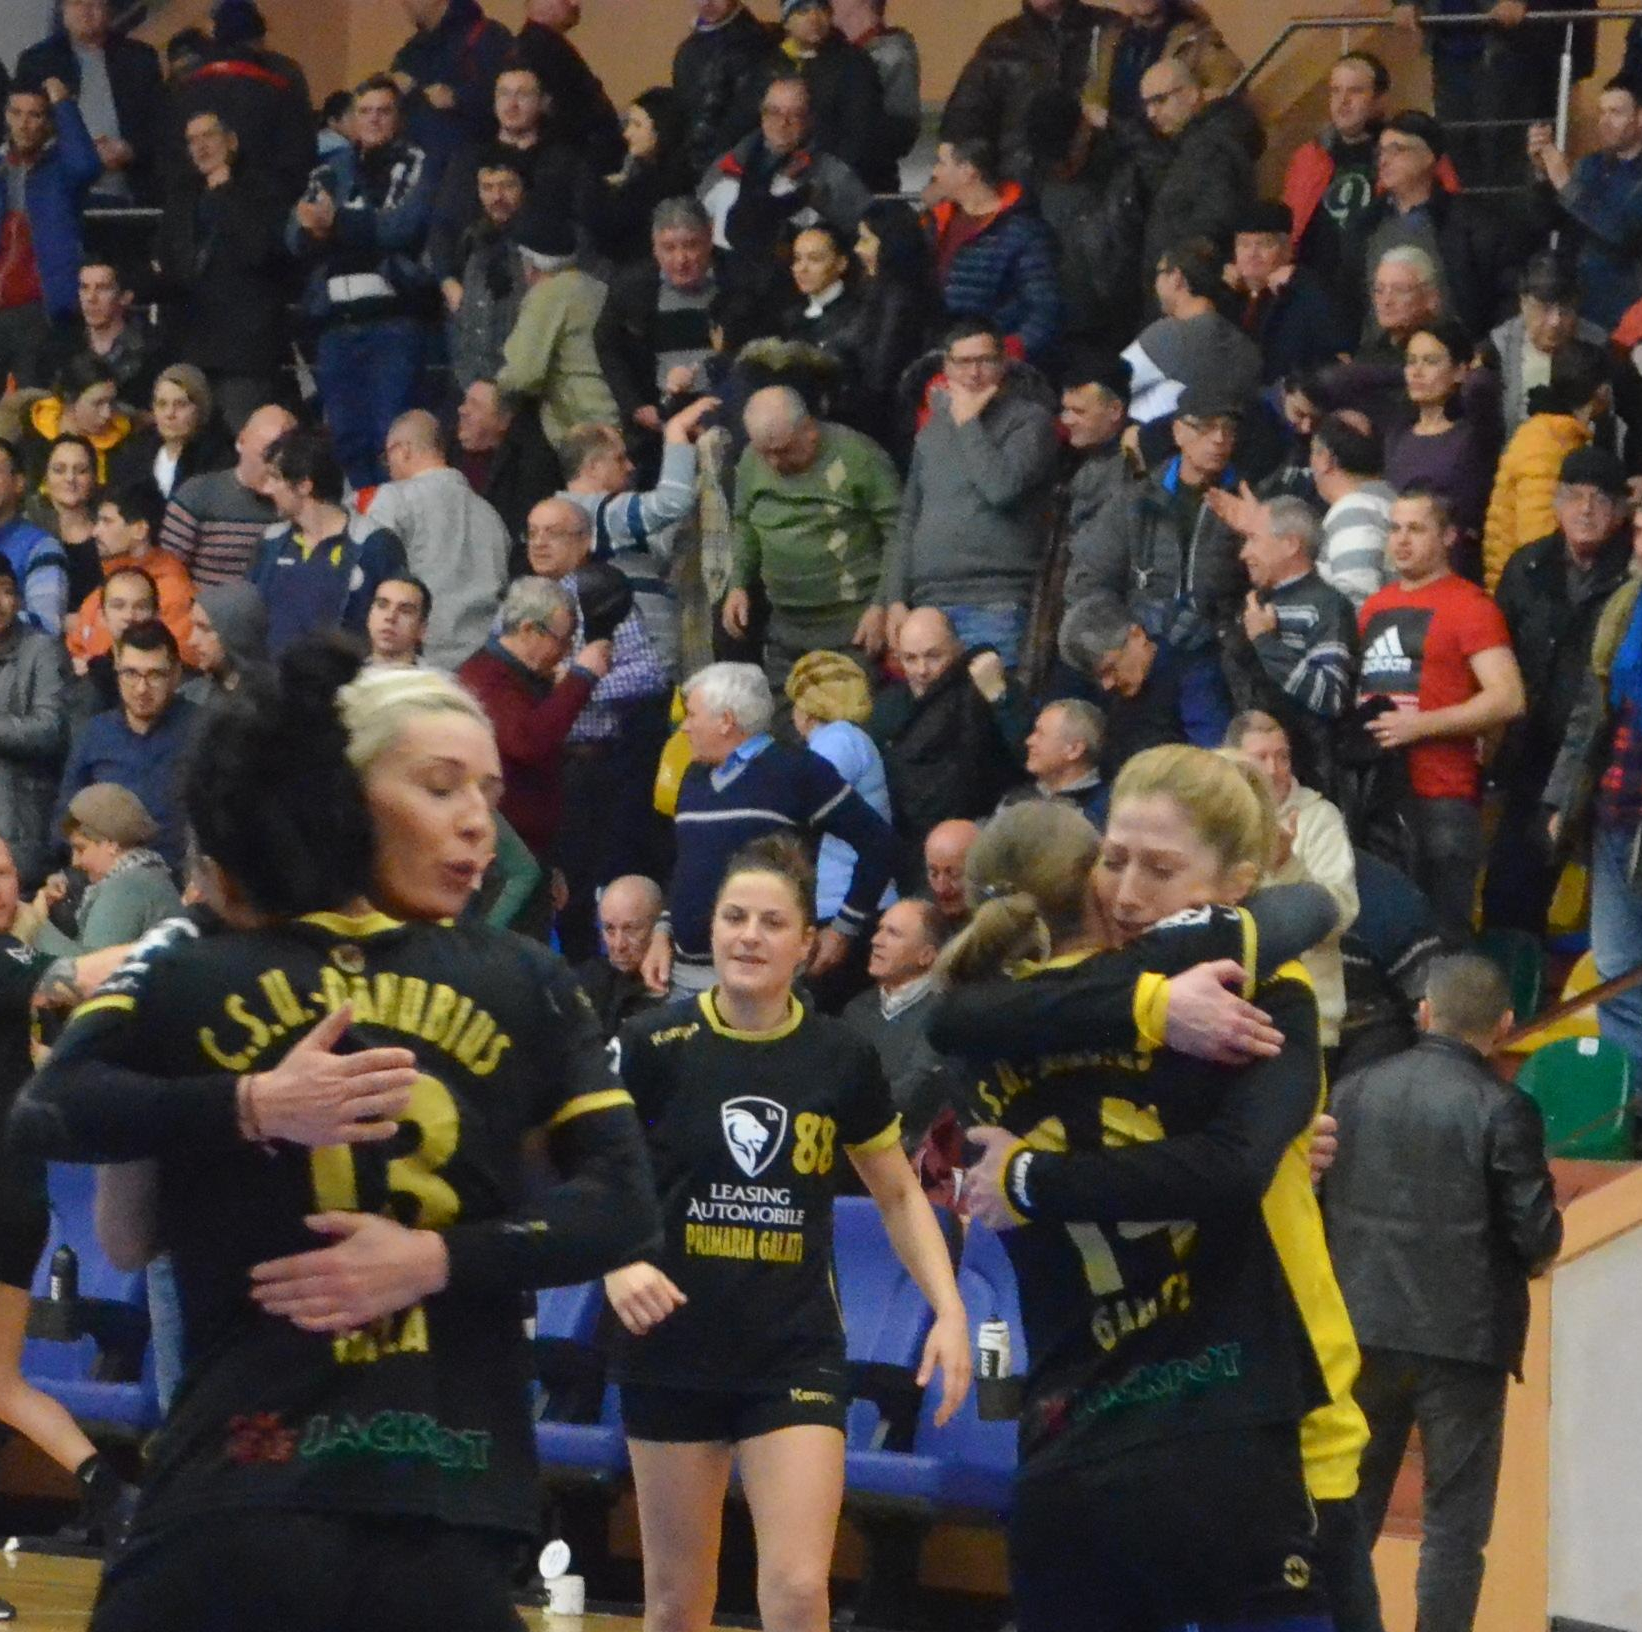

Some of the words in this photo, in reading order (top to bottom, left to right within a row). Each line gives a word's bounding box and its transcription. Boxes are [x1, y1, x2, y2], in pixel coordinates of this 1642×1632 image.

[1361, 657, 1412, 676] adidas
[792, 1111, 837, 1176] 88
[710, 1183, 791, 1206] LEASING
[686, 1197, 806, 1226] AUTOMOBILE
[686, 1223, 755, 1260] PRIMARIA
